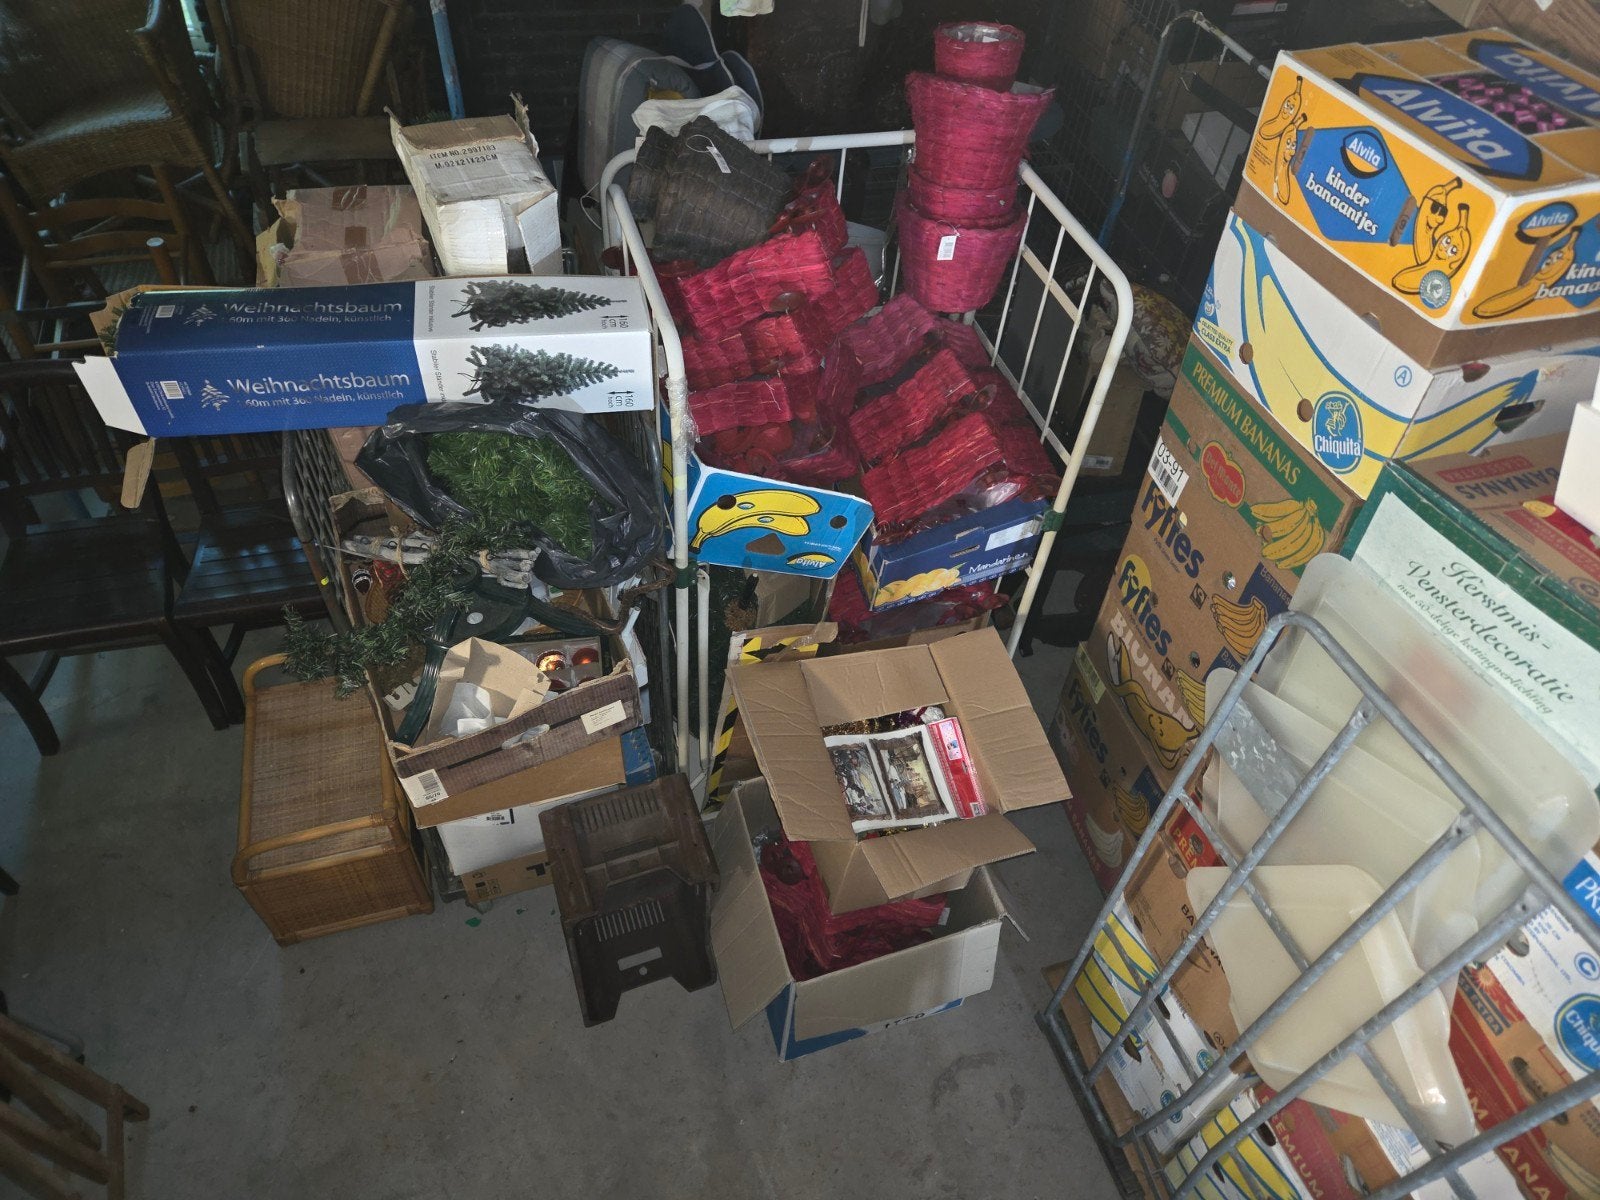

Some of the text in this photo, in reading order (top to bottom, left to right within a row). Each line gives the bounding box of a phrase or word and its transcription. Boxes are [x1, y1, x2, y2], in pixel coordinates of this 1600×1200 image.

[1372, 88, 1513, 160] Alvita
[1348, 137, 1382, 167] Alvita
[1325, 166, 1370, 208] kinder
[1305, 172, 1379, 236] banaantjes
[1526, 211, 1570, 229] Alvita
[224, 301, 402, 314] Weihnachtsbaum
[256, 314, 275, 323] mit
[301, 314, 342, 325] Nadeln,
[344, 313, 392, 323] künstlich
[610, 318, 617, 328] cm
[1215, 337, 1231, 353] EXTRA
[227, 372, 410, 395] Weihnachtsbaum
[271, 396, 291, 405] mit
[314, 393, 354, 405] Nadeln,
[356, 389, 404, 400] künstlich
[616, 395, 623, 406] cm
[626, 394, 635, 407] 160
[1192, 362, 1301, 486] PREMIUM BANANAS
[1314, 434, 1362, 459] Chiquita
[1157, 442, 1185, 482] 03-91
[1204, 452, 1242, 498] Del Monte
[796, 557, 828, 569] Alvita
[1397, 584, 1416, 601] met
[1441, 562, 1541, 643] Kerstmis
[1406, 560, 1575, 703] Vensterdecoratie
